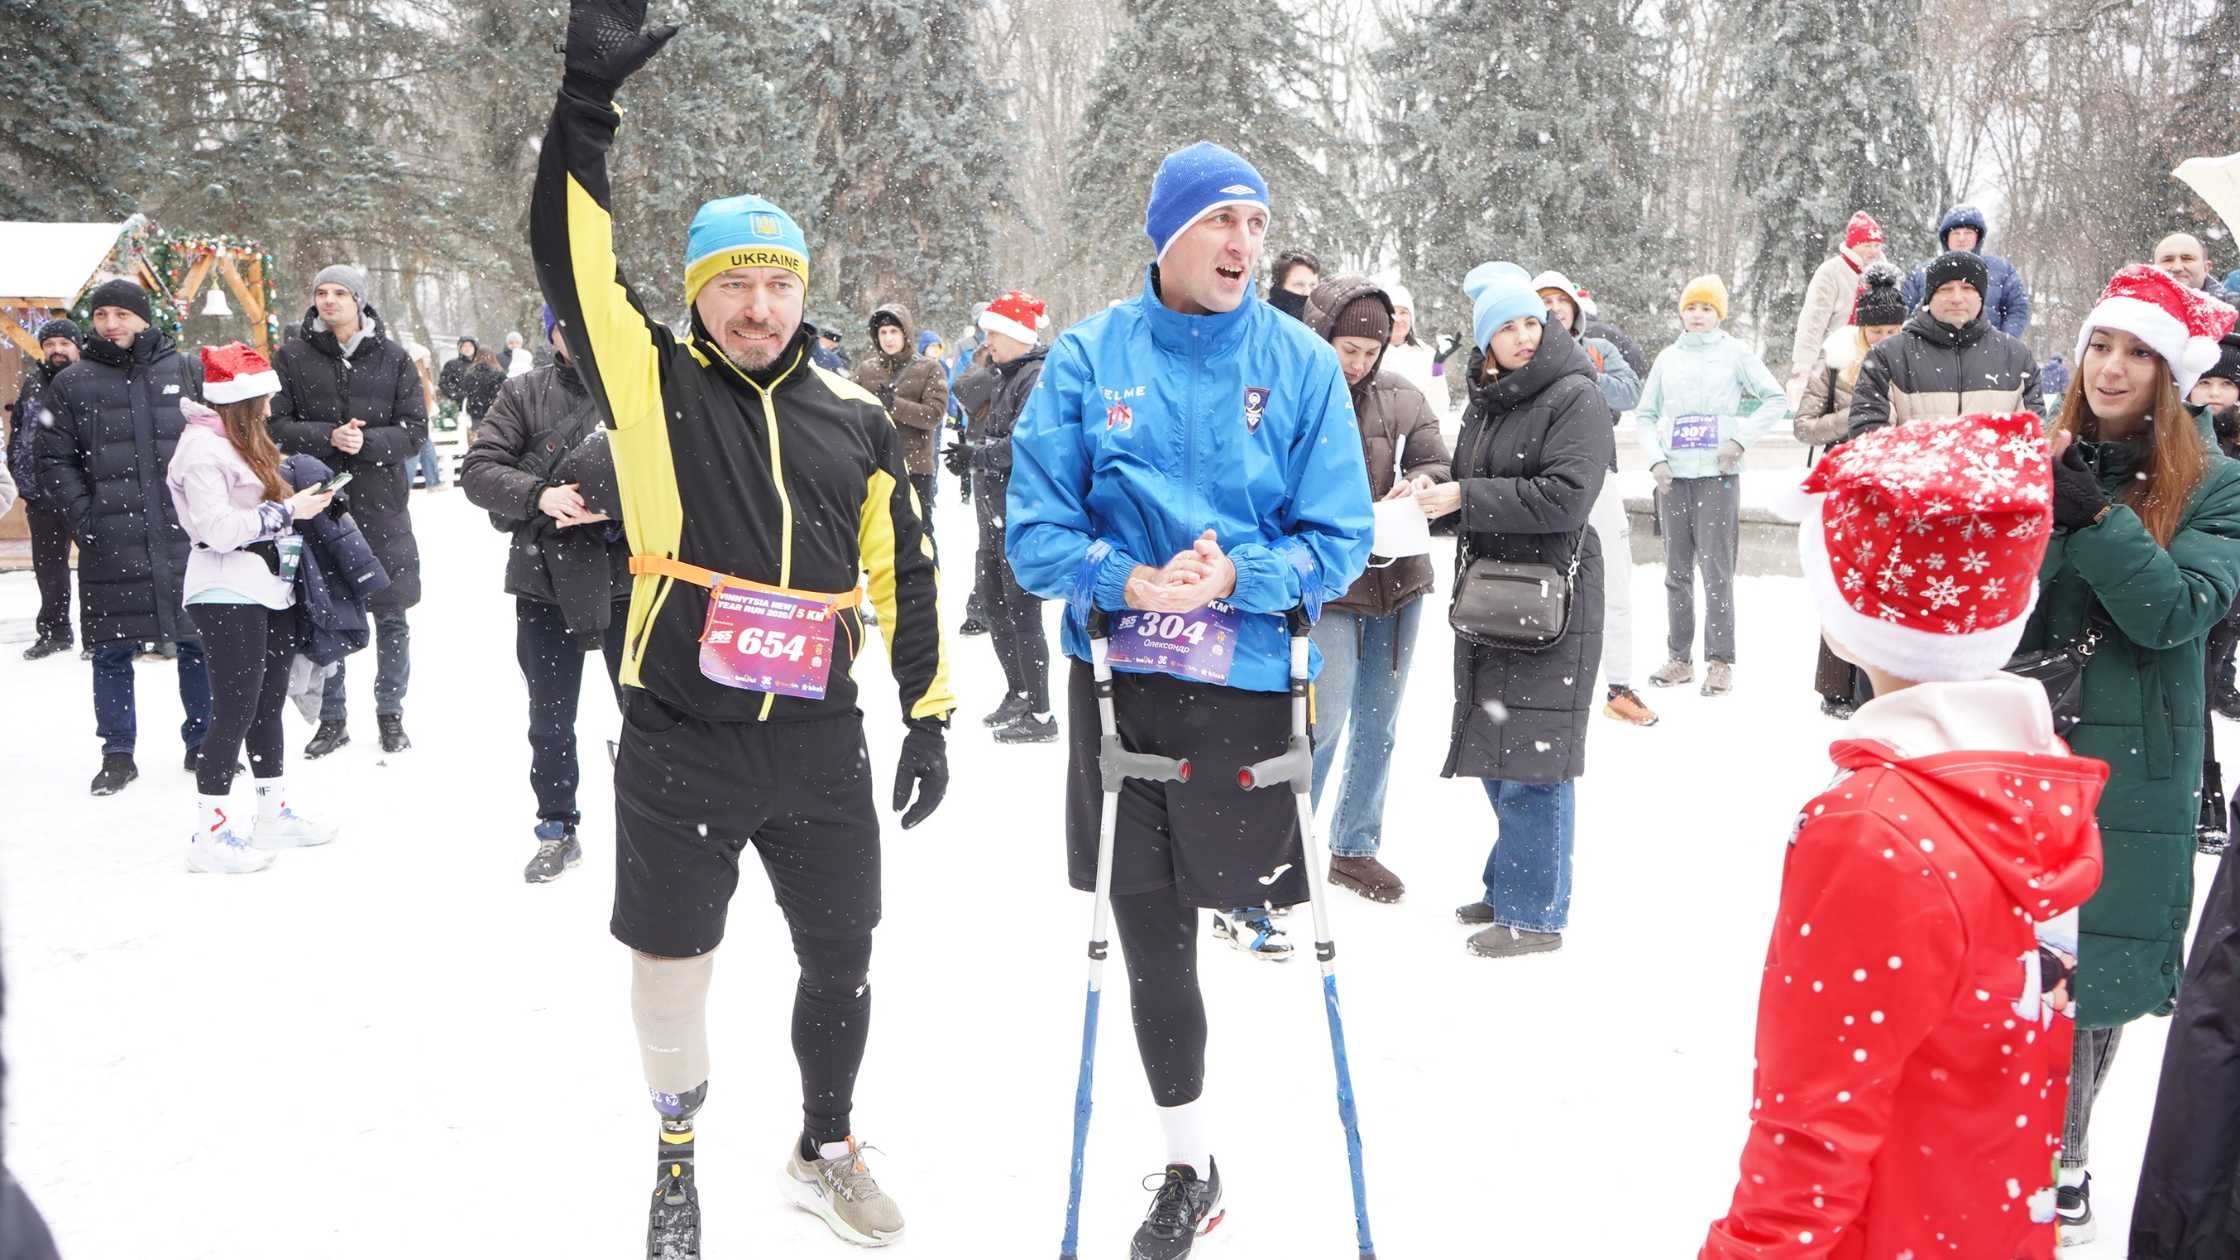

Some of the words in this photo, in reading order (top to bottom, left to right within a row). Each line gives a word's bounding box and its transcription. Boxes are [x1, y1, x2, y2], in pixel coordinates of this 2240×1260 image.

[731, 253, 800, 270] UKRAINE
[718, 600, 743, 611] YEAR
[743, 605, 766, 615] RUN
[770, 601, 793, 611] NEW
[795, 608, 806, 619] 5
[1208, 600, 1229, 613] KM
[1138, 612, 1208, 645] 304
[737, 627, 807, 662] 654
